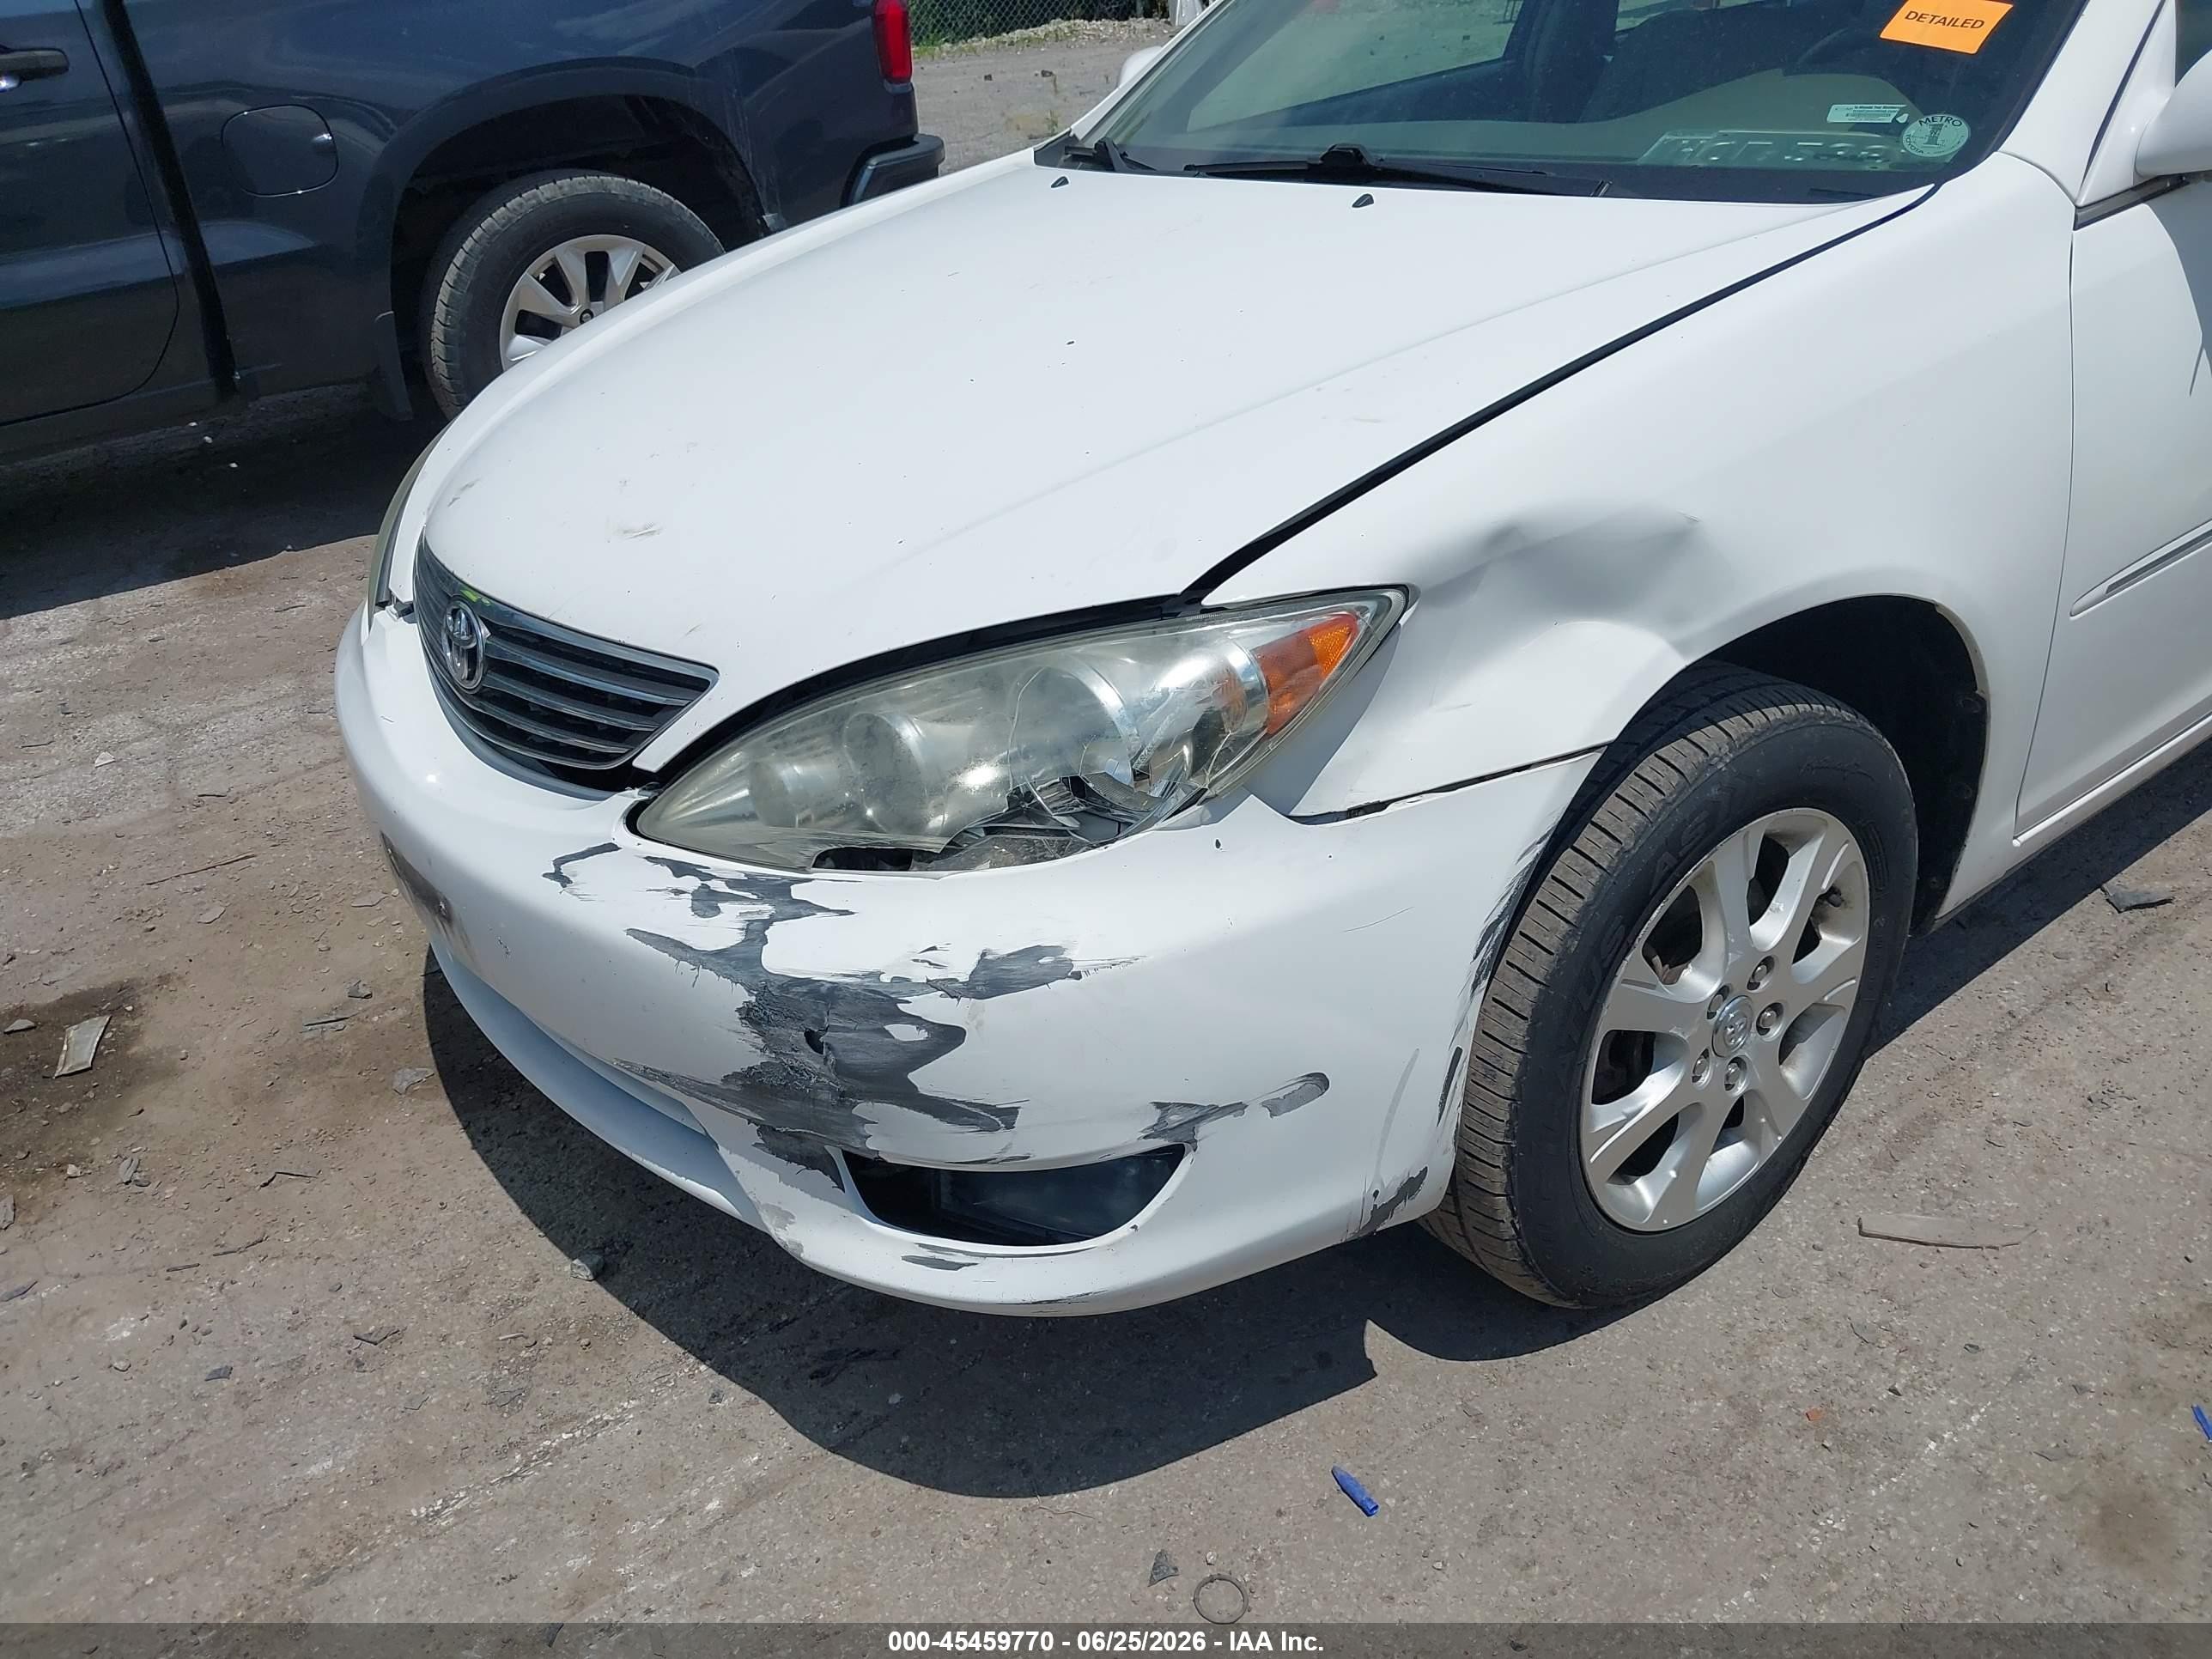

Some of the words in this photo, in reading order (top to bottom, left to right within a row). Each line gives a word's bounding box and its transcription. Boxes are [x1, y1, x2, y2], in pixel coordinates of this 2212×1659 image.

[1905, 10, 1985, 29] DETAILED
[1917, 115, 1963, 127] METRO
[1905, 133, 1924, 154] TOYOTA
